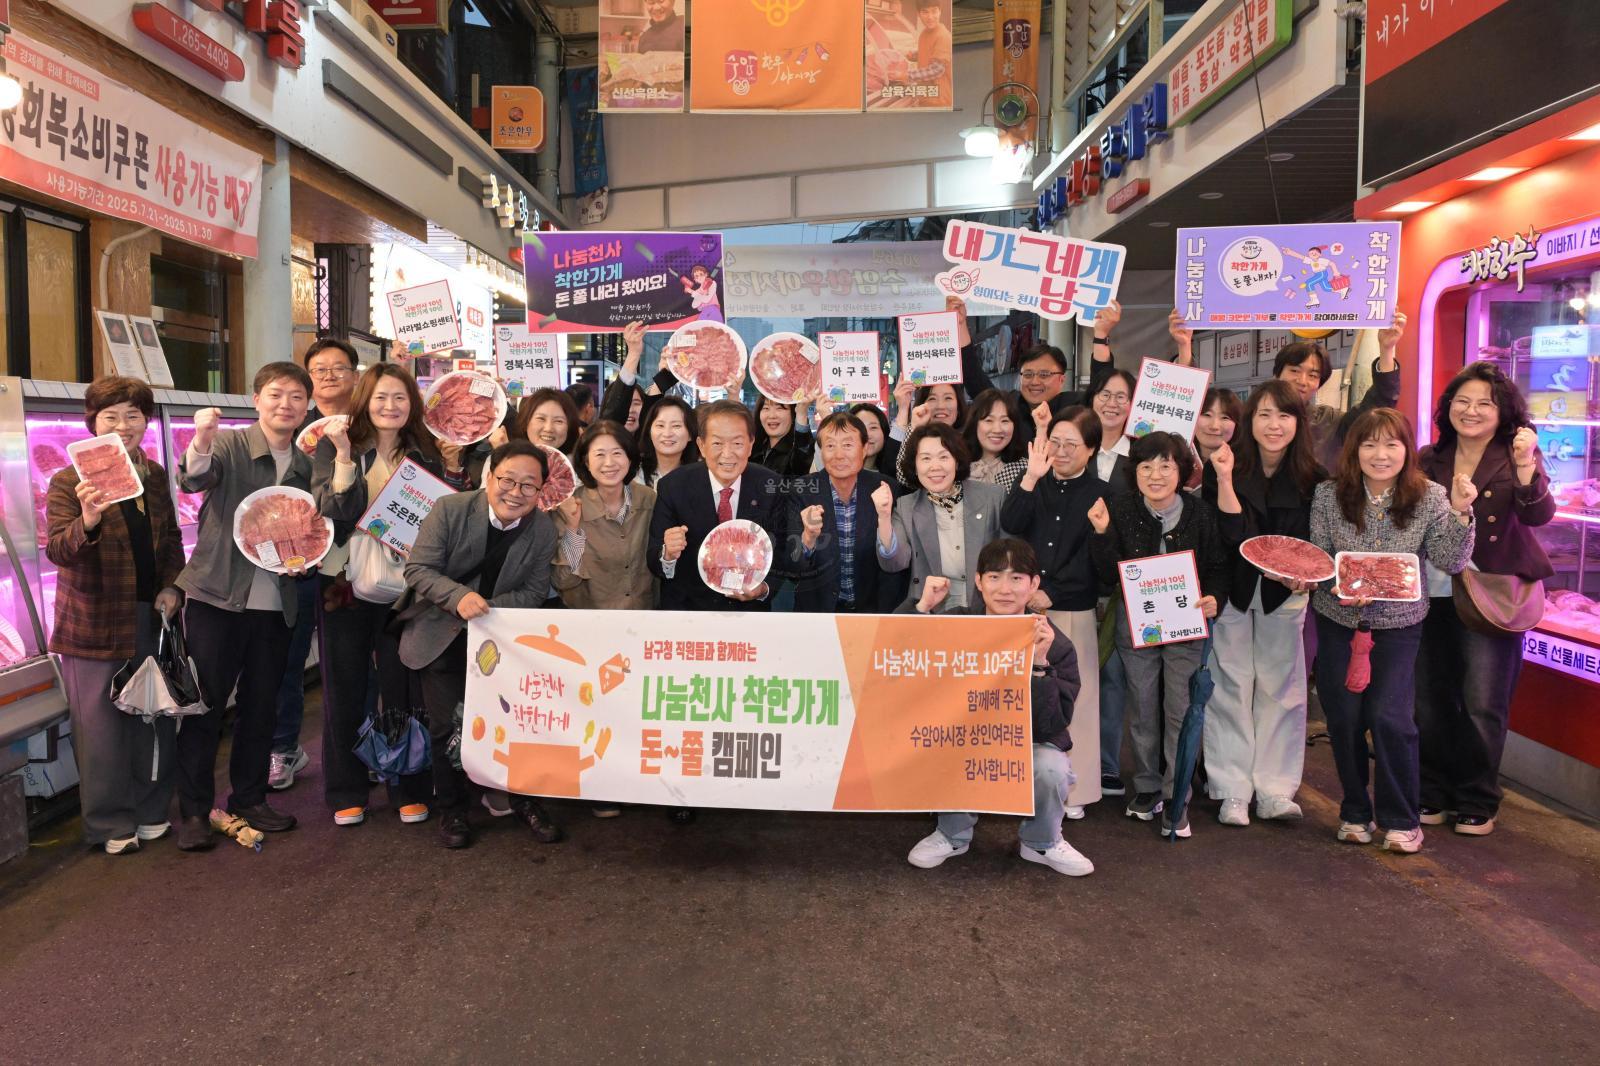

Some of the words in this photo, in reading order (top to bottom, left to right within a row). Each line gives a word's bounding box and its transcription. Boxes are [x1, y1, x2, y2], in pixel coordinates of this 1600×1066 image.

[1376, 3, 1409, 48] 내가
[170, 16, 229, 70] T.265-4409
[1199, 58, 1220, 94] 홍삼
[881, 84, 940, 98] 삼육식육점
[498, 125, 534, 137] 조은한우
[154, 143, 220, 219] 사용가능
[553, 239, 623, 270] 나눔천사
[1546, 233, 1577, 256] 이바지
[554, 262, 624, 289] 착한가게
[1044, 241, 1120, 285] 네게
[1366, 230, 1391, 321] 착한가게
[554, 291, 570, 309] 돈
[590, 283, 619, 301] 내러
[621, 273, 668, 297] 왔어요!
[1184, 236, 1207, 322] 나눔천사
[1233, 276, 1242, 289] 돈
[1253, 269, 1278, 282] 내자!
[972, 285, 1015, 302] 힘이되는
[1016, 293, 1040, 308] 천사
[1039, 276, 1112, 321] 남구
[397, 314, 454, 335] 서라벌쇼핑센터
[430, 338, 458, 350] 감사합니다
[504, 358, 554, 371] 경북식육점
[932, 374, 958, 382] 감사합니다
[1136, 399, 1194, 421] 서라벌식육점
[1143, 600, 1155, 614] 촌
[1175, 594, 1188, 608] 당
[1169, 627, 1202, 638] 감사합니다
[643, 639, 673, 660] 남구청
[675, 640, 715, 662] 직원들과
[717, 640, 758, 662] 함께하는
[874, 647, 930, 678] 나눔천사
[933, 650, 948, 678] 구
[951, 650, 979, 677] 선포
[982, 647, 1026, 676] 10주년
[1551, 645, 1600, 677] 선물세트
[519, 671, 565, 700] 나눔천사
[641, 673, 736, 723] 나눔천사
[742, 674, 840, 726] 착한가게
[967, 688, 1000, 712] 함께해
[1003, 687, 1024, 711] 주신
[513, 703, 571, 734] 착한가게
[910, 724, 966, 748] 수암야시장
[969, 722, 1025, 747] 상인여러분
[640, 728, 704, 777] 돈~쭐
[711, 731, 782, 779] 캠페인
[964, 757, 1025, 783] 감사합니다!
